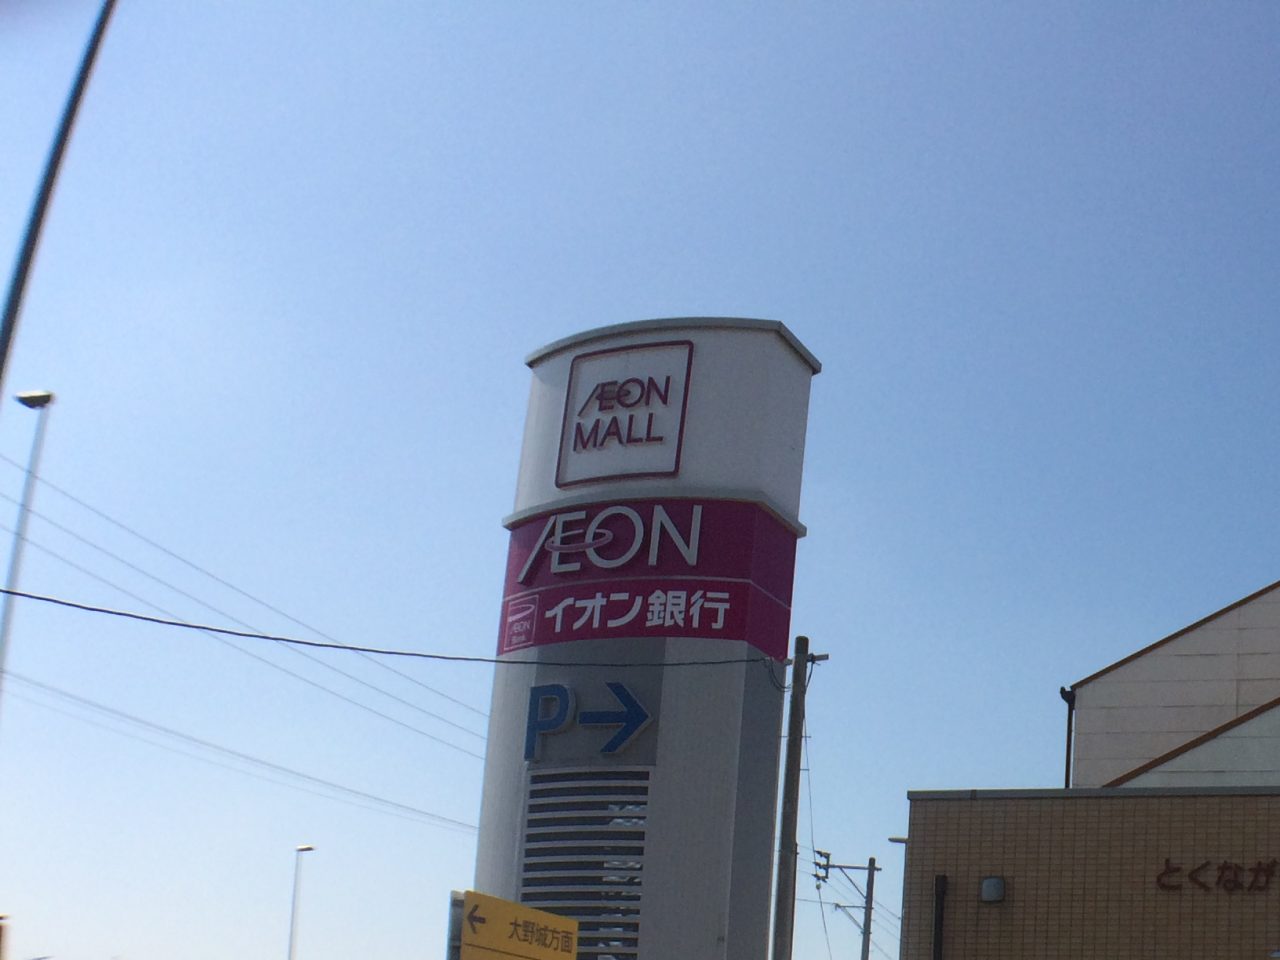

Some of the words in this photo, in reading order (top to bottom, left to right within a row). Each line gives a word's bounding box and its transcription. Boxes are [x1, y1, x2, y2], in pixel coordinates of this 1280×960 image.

[572, 412, 664, 452] MALL
[545, 589, 731, 633] イオン銀行
[524, 684, 570, 761] P
[508, 916, 574, 953] 大野城方面
